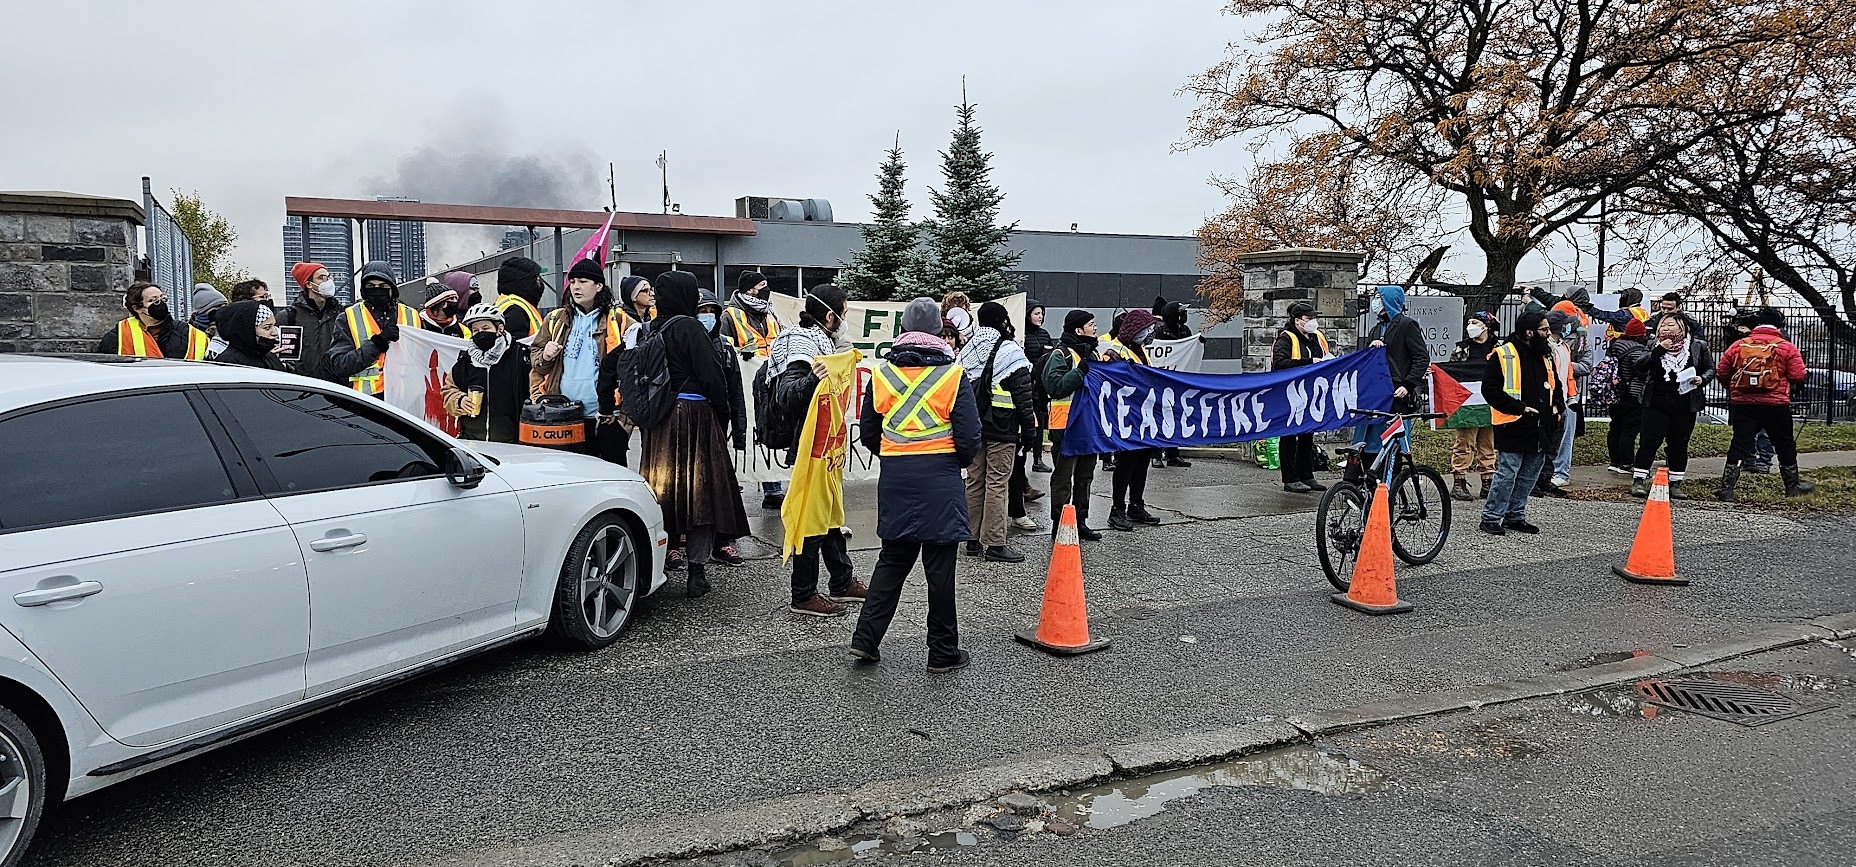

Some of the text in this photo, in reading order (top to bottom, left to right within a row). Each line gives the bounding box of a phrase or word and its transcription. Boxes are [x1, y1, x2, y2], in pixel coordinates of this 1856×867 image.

[1144, 346, 1173, 359] TOP
[1098, 369, 1359, 440] CEASEFIRE NOW
[532, 429, 574, 440] D. CRUPI
